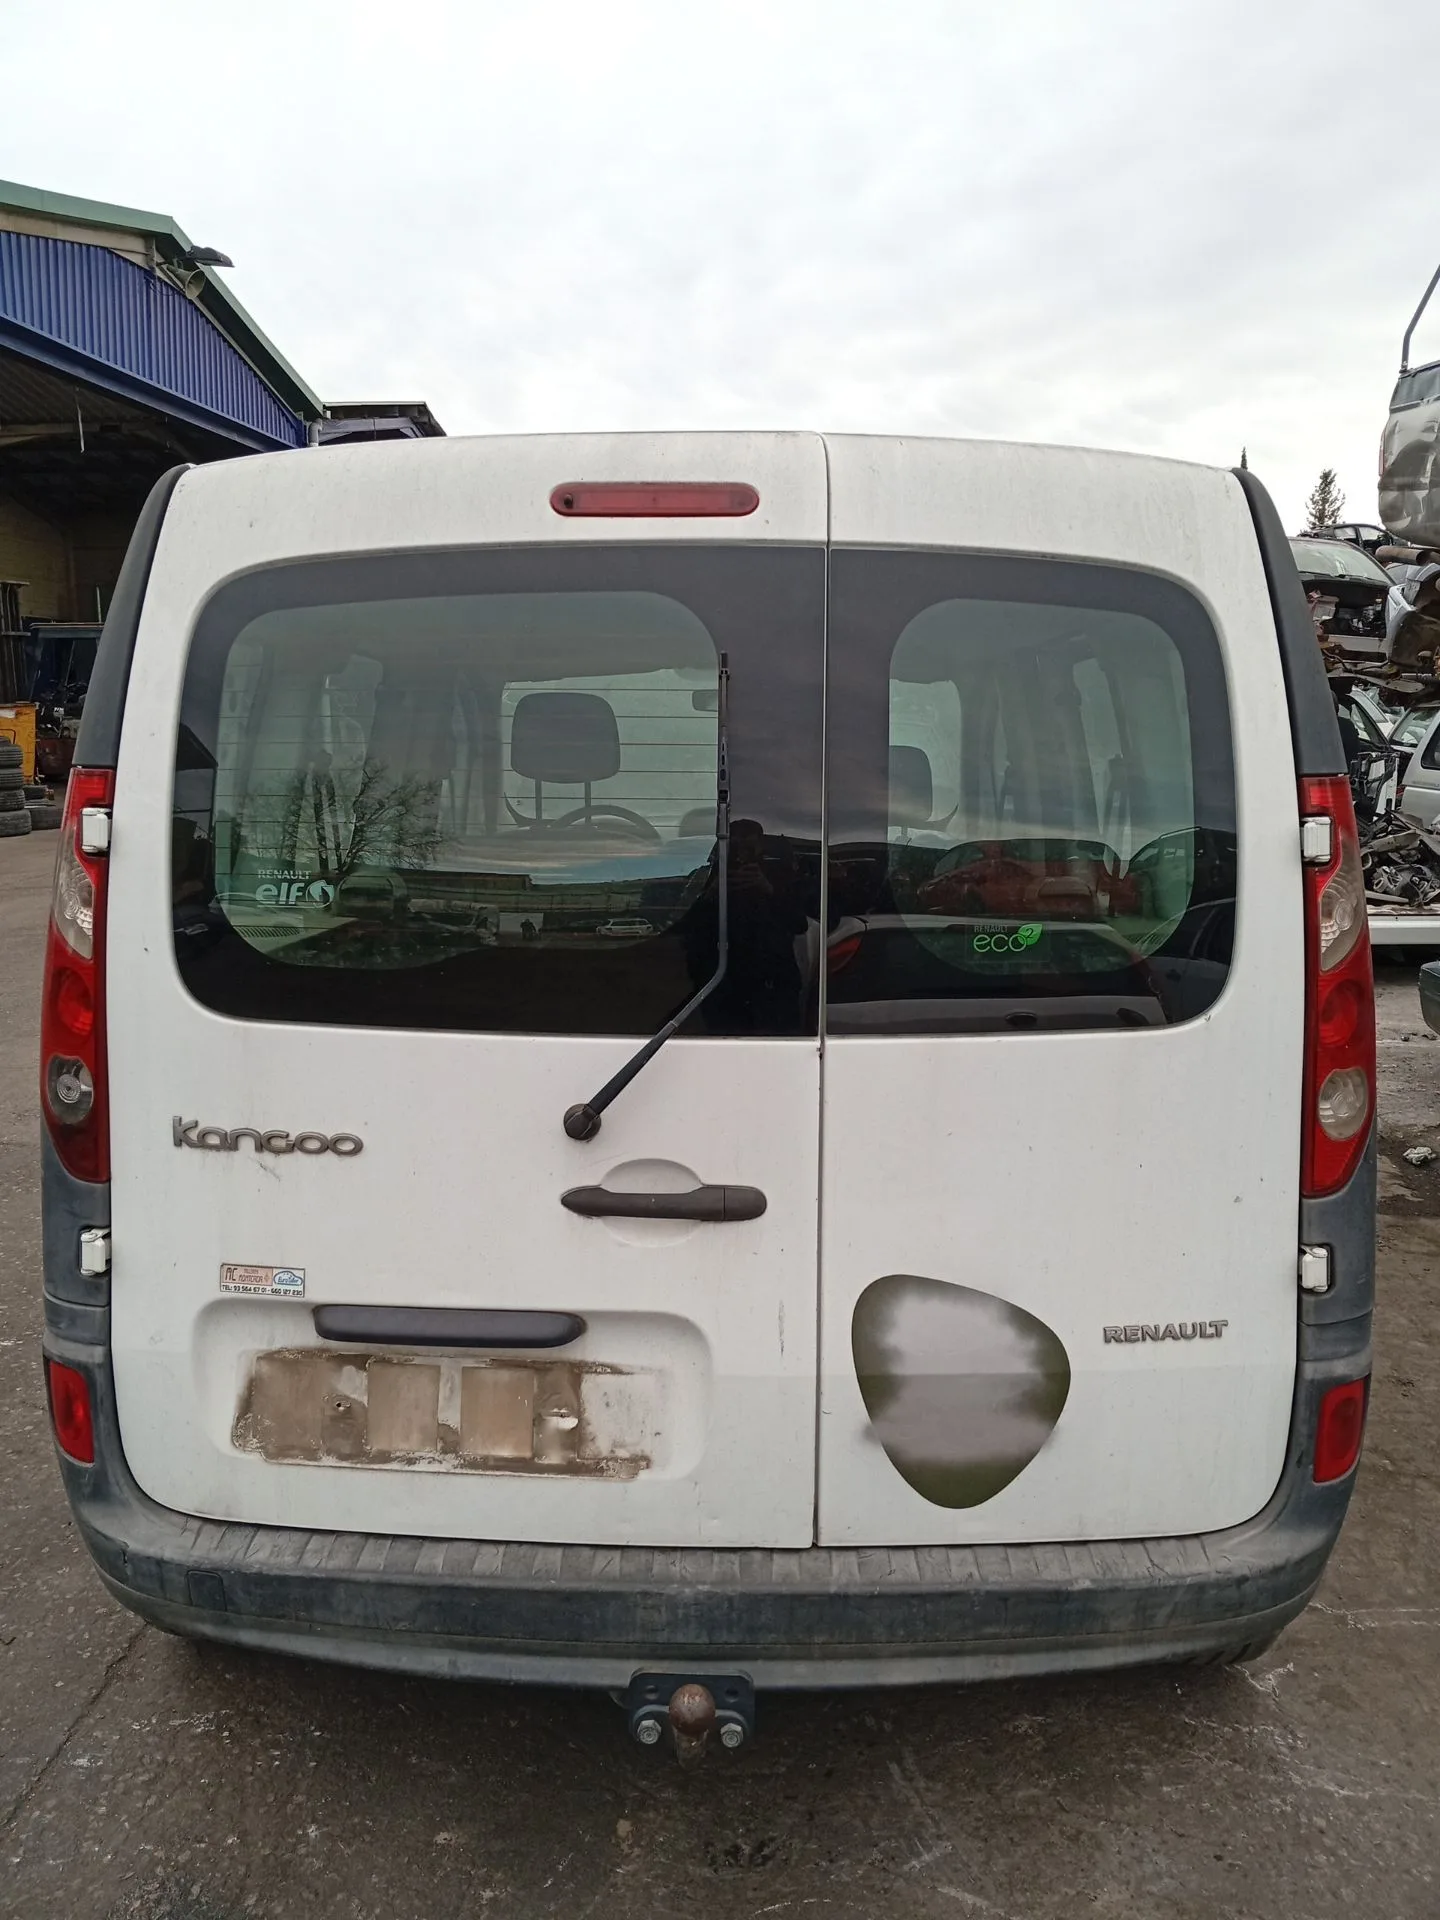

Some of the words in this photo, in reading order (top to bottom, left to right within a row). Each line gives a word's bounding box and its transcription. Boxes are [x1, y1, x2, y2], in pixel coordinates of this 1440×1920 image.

[258, 869, 312, 879] RENAULT
[256, 882, 305, 905] elf
[974, 924, 1008, 933] RENAULT
[1103, 1320, 1229, 1343] RENAULT
